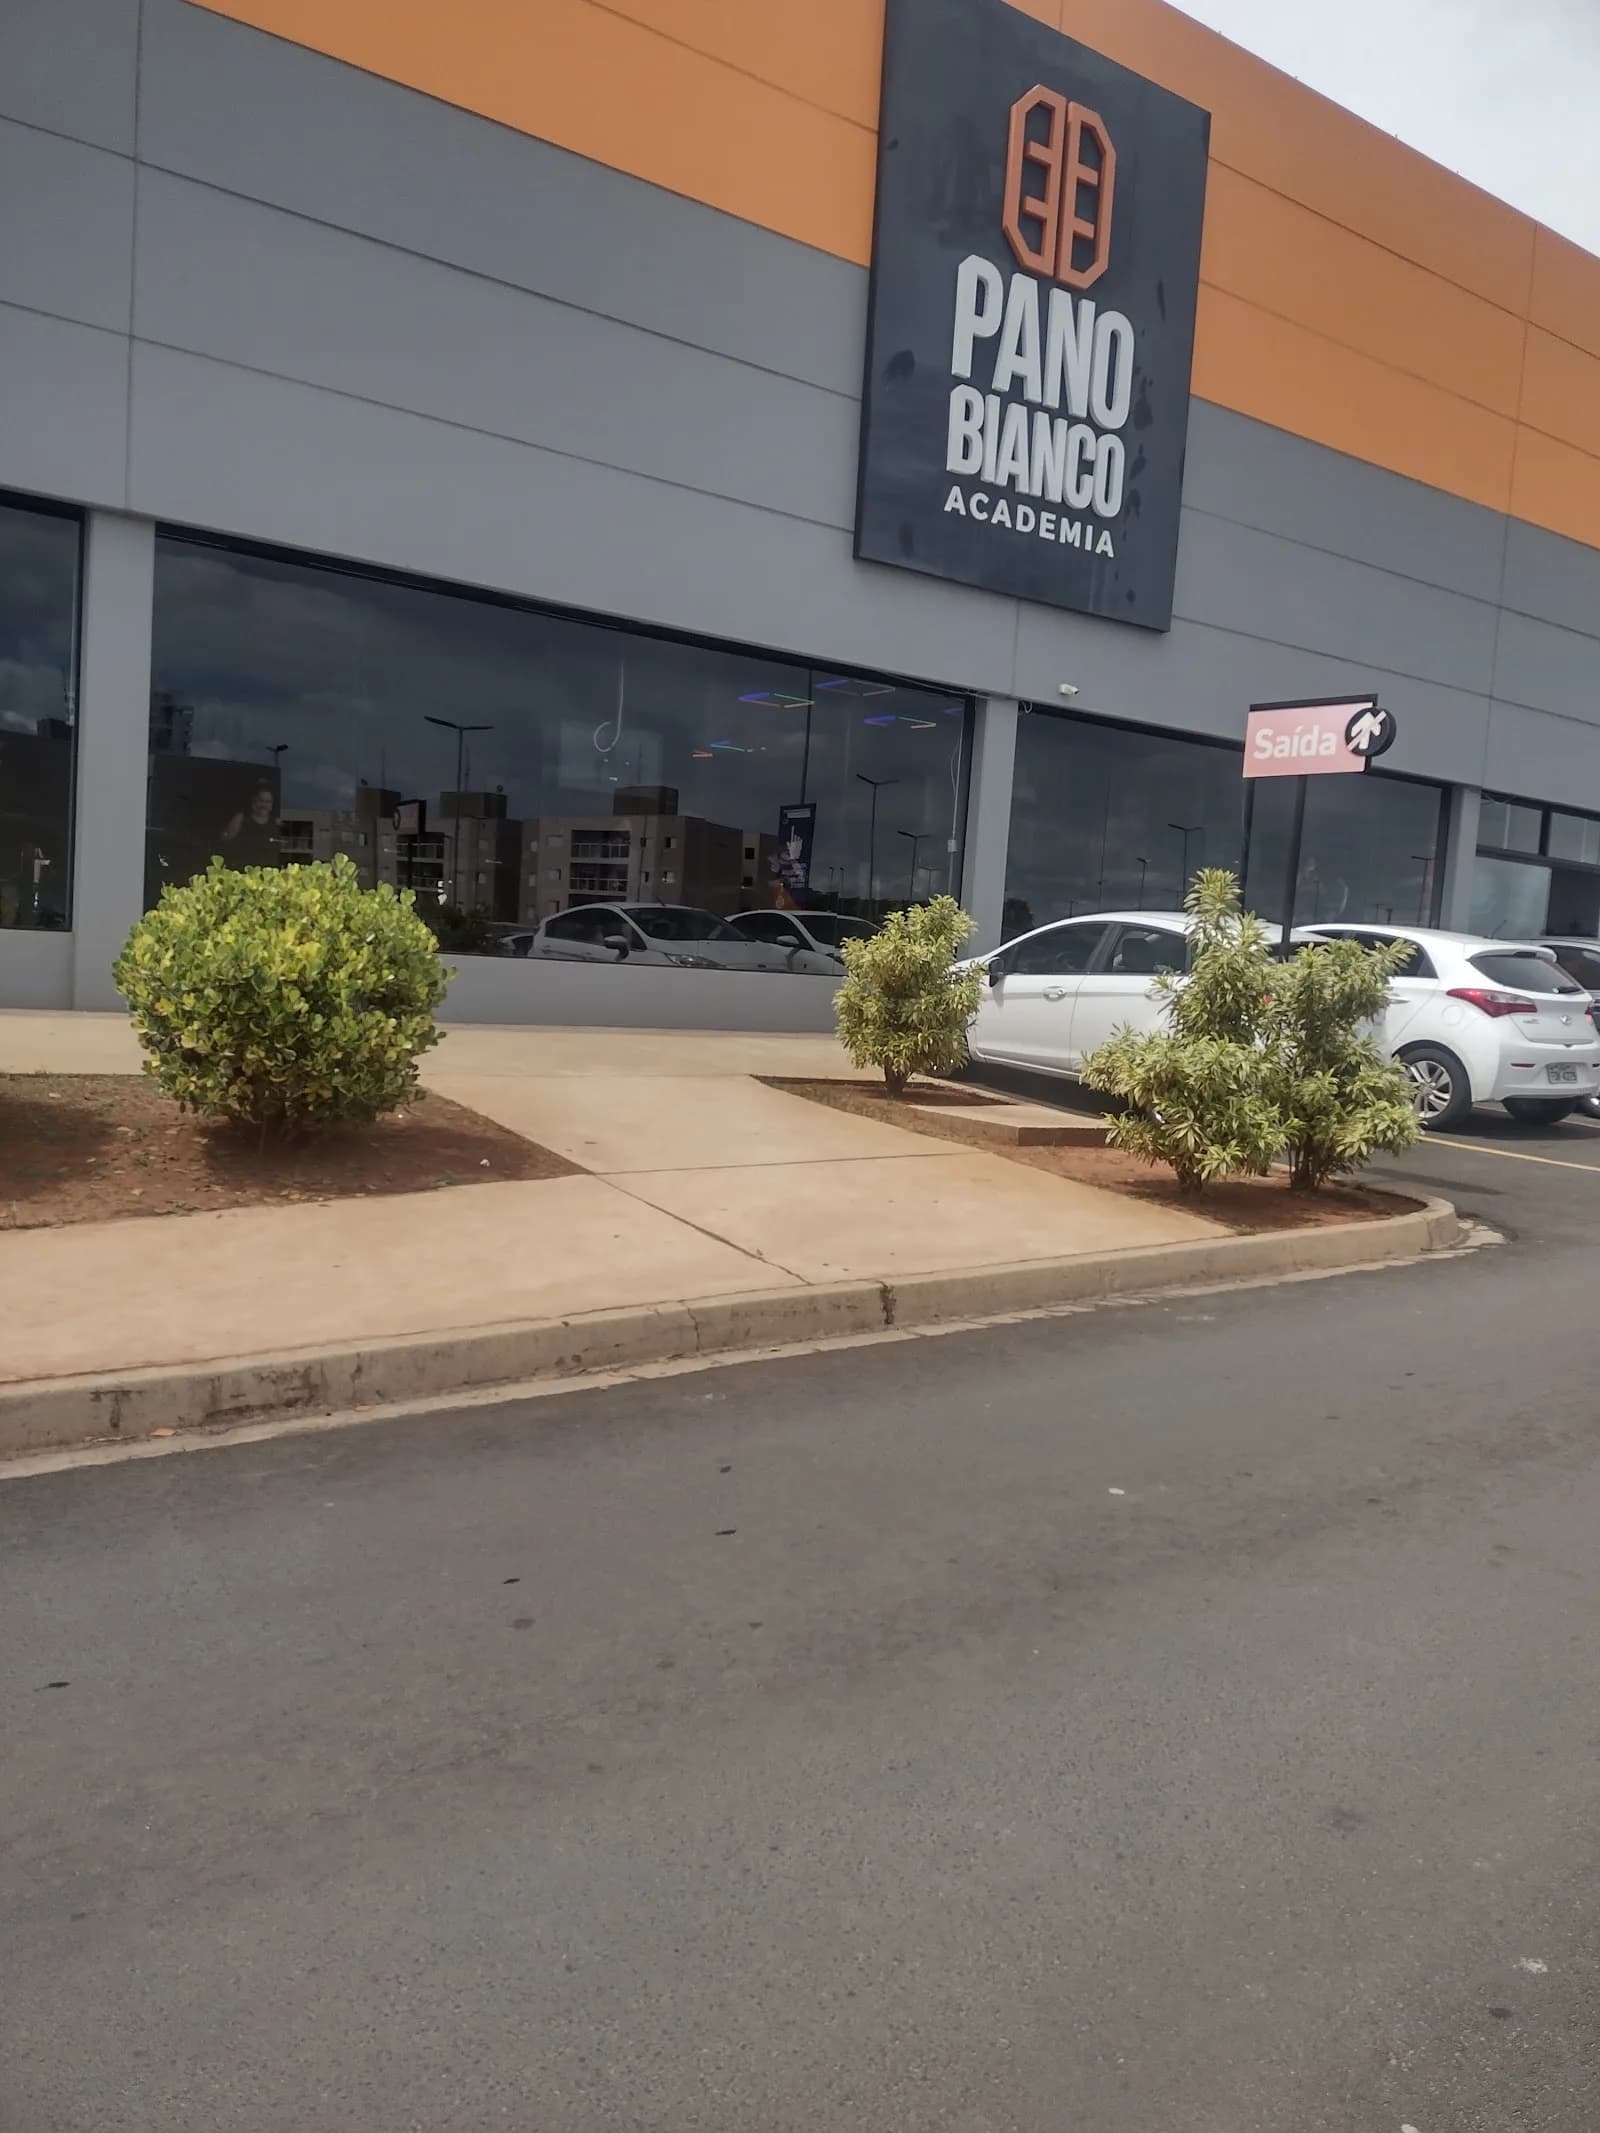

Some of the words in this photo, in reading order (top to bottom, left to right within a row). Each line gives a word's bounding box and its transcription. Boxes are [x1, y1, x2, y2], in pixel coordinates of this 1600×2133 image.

[951, 254, 1135, 430] PANO
[946, 384, 1125, 518] BIANCO
[943, 485, 1115, 558] ACADEMIA
[1253, 724, 1338, 760] Saída
